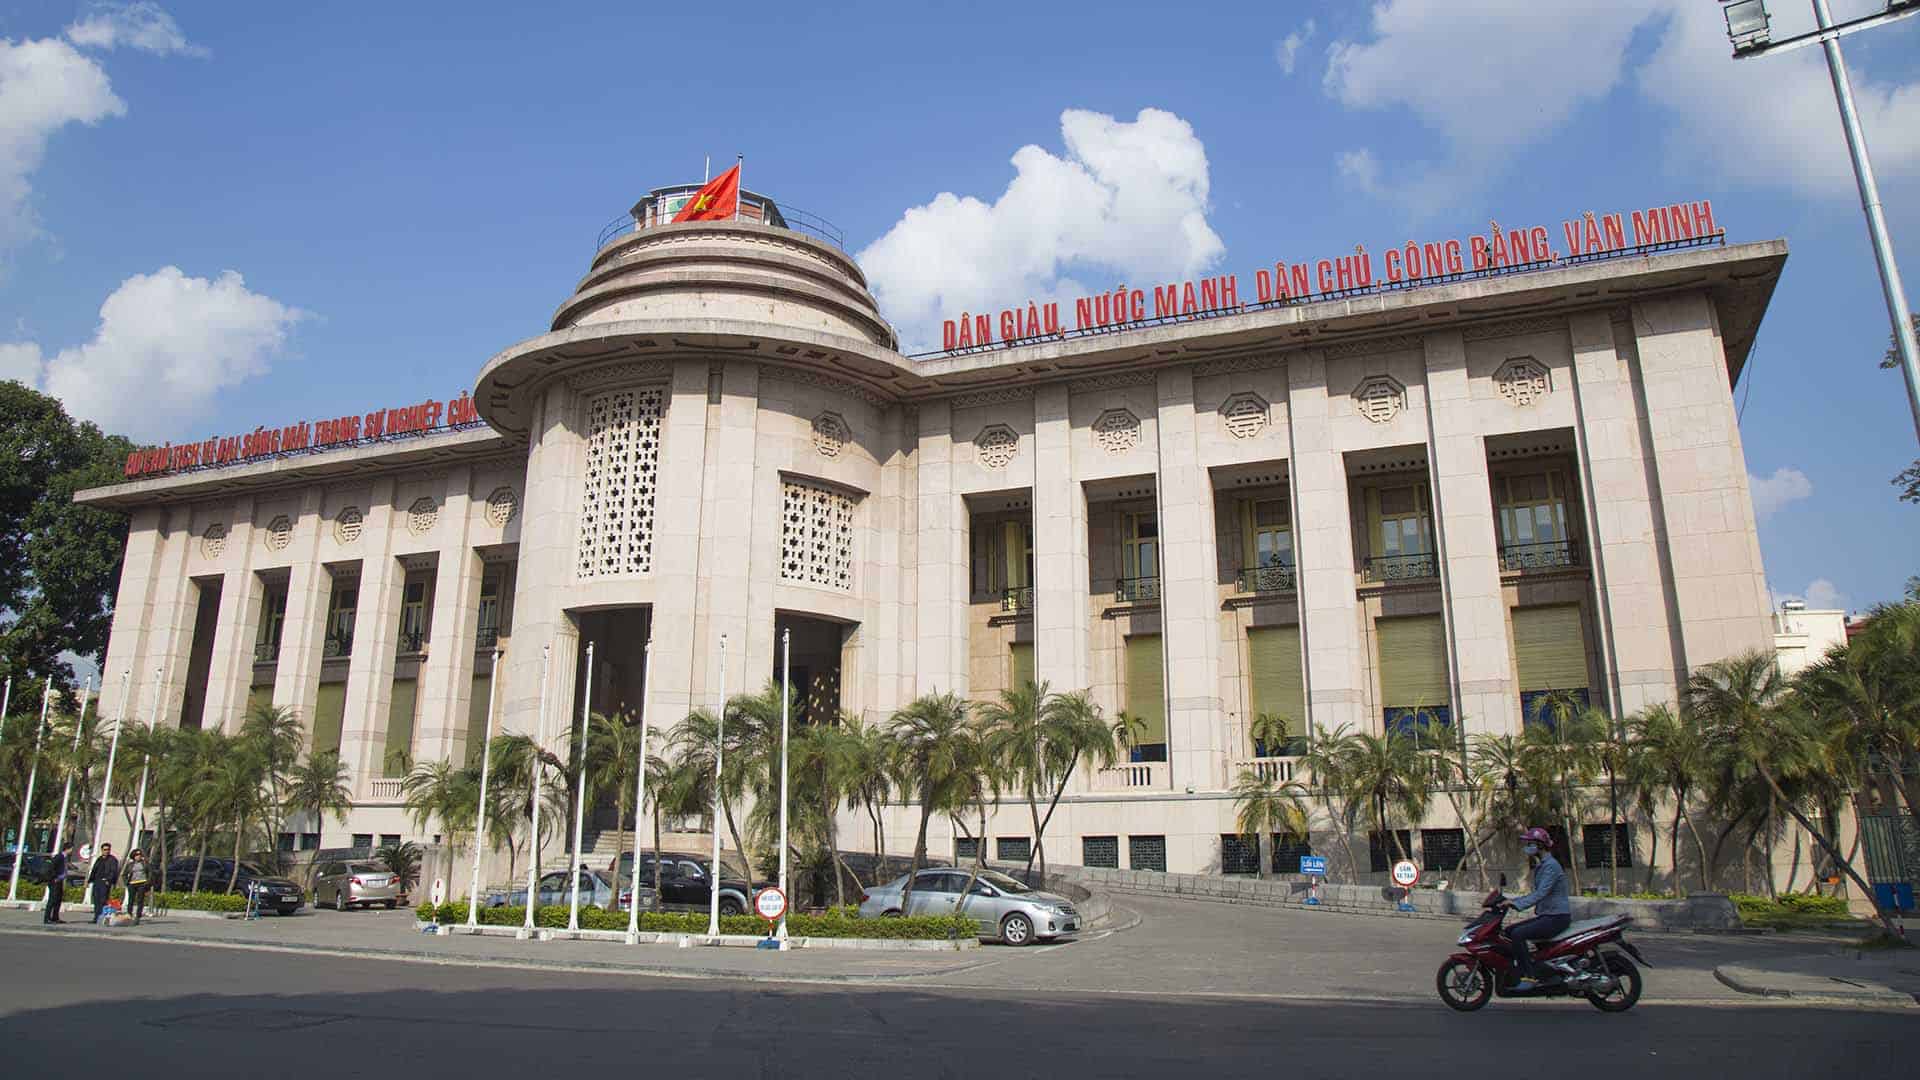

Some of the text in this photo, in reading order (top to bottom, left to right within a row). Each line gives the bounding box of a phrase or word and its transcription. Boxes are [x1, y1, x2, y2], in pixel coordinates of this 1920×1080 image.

[943, 311, 992, 351] DÂN
[1000, 301, 1066, 340] GIÀU,
[1077, 284, 1144, 329] NƯỚC
[1155, 275, 1245, 321] MẠNH,
[1256, 260, 1310, 301] DÂN
[1386, 240, 1464, 283] CÔNG
[1470, 220, 1558, 273] BẰNG,
[1564, 210, 1625, 256] VĂN
[241, 425, 281, 459] SỐNG
[314, 415, 361, 445] TRONG
[363, 408, 386, 440] SỰ
[386, 399, 442, 434] NGHIỆP
